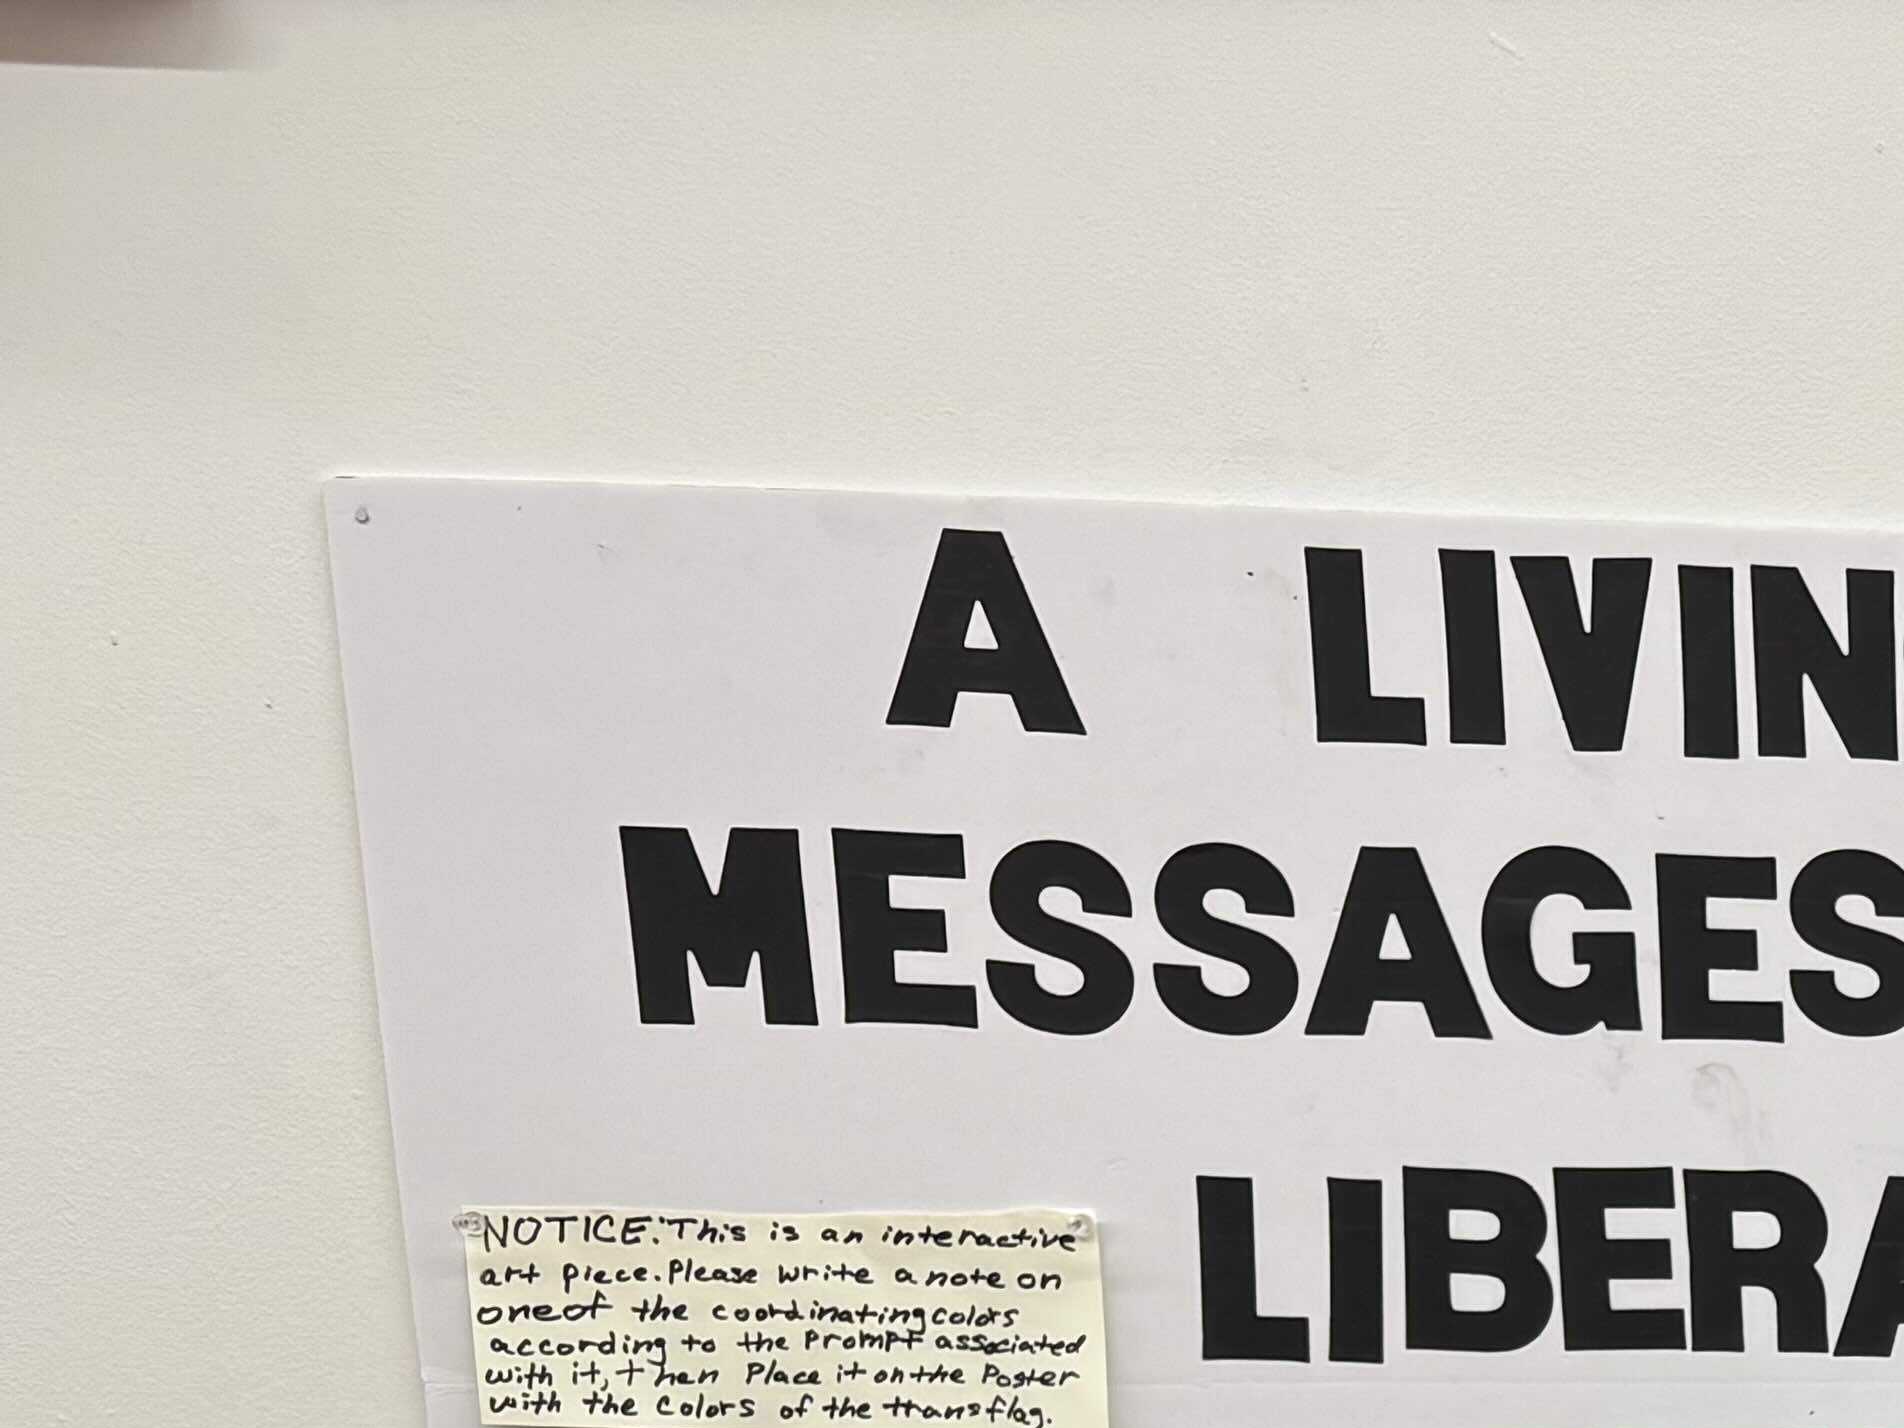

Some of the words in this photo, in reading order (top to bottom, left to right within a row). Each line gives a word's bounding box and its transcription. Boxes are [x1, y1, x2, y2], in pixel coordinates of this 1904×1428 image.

[884, 528, 1087, 735] A
[769, 1222, 799, 1243] is
[822, 1228, 864, 1247] an
[880, 1225, 1078, 1253] interactive
[480, 1264, 540, 1287] art
[778, 1264, 873, 1286] write
[1017, 1270, 1062, 1290] on
[632, 1295, 689, 1322] the
[490, 1332, 667, 1364] according
[682, 1336, 716, 1354] to
[738, 1329, 788, 1352] the
[934, 1332, 1086, 1357] associated
[485, 1365, 553, 1387] with
[836, 1364, 867, 1382] it
[489, 1394, 561, 1416] with
[583, 1394, 637, 1416] the
[780, 1393, 813, 1420] of
[823, 1396, 871, 1418] the
